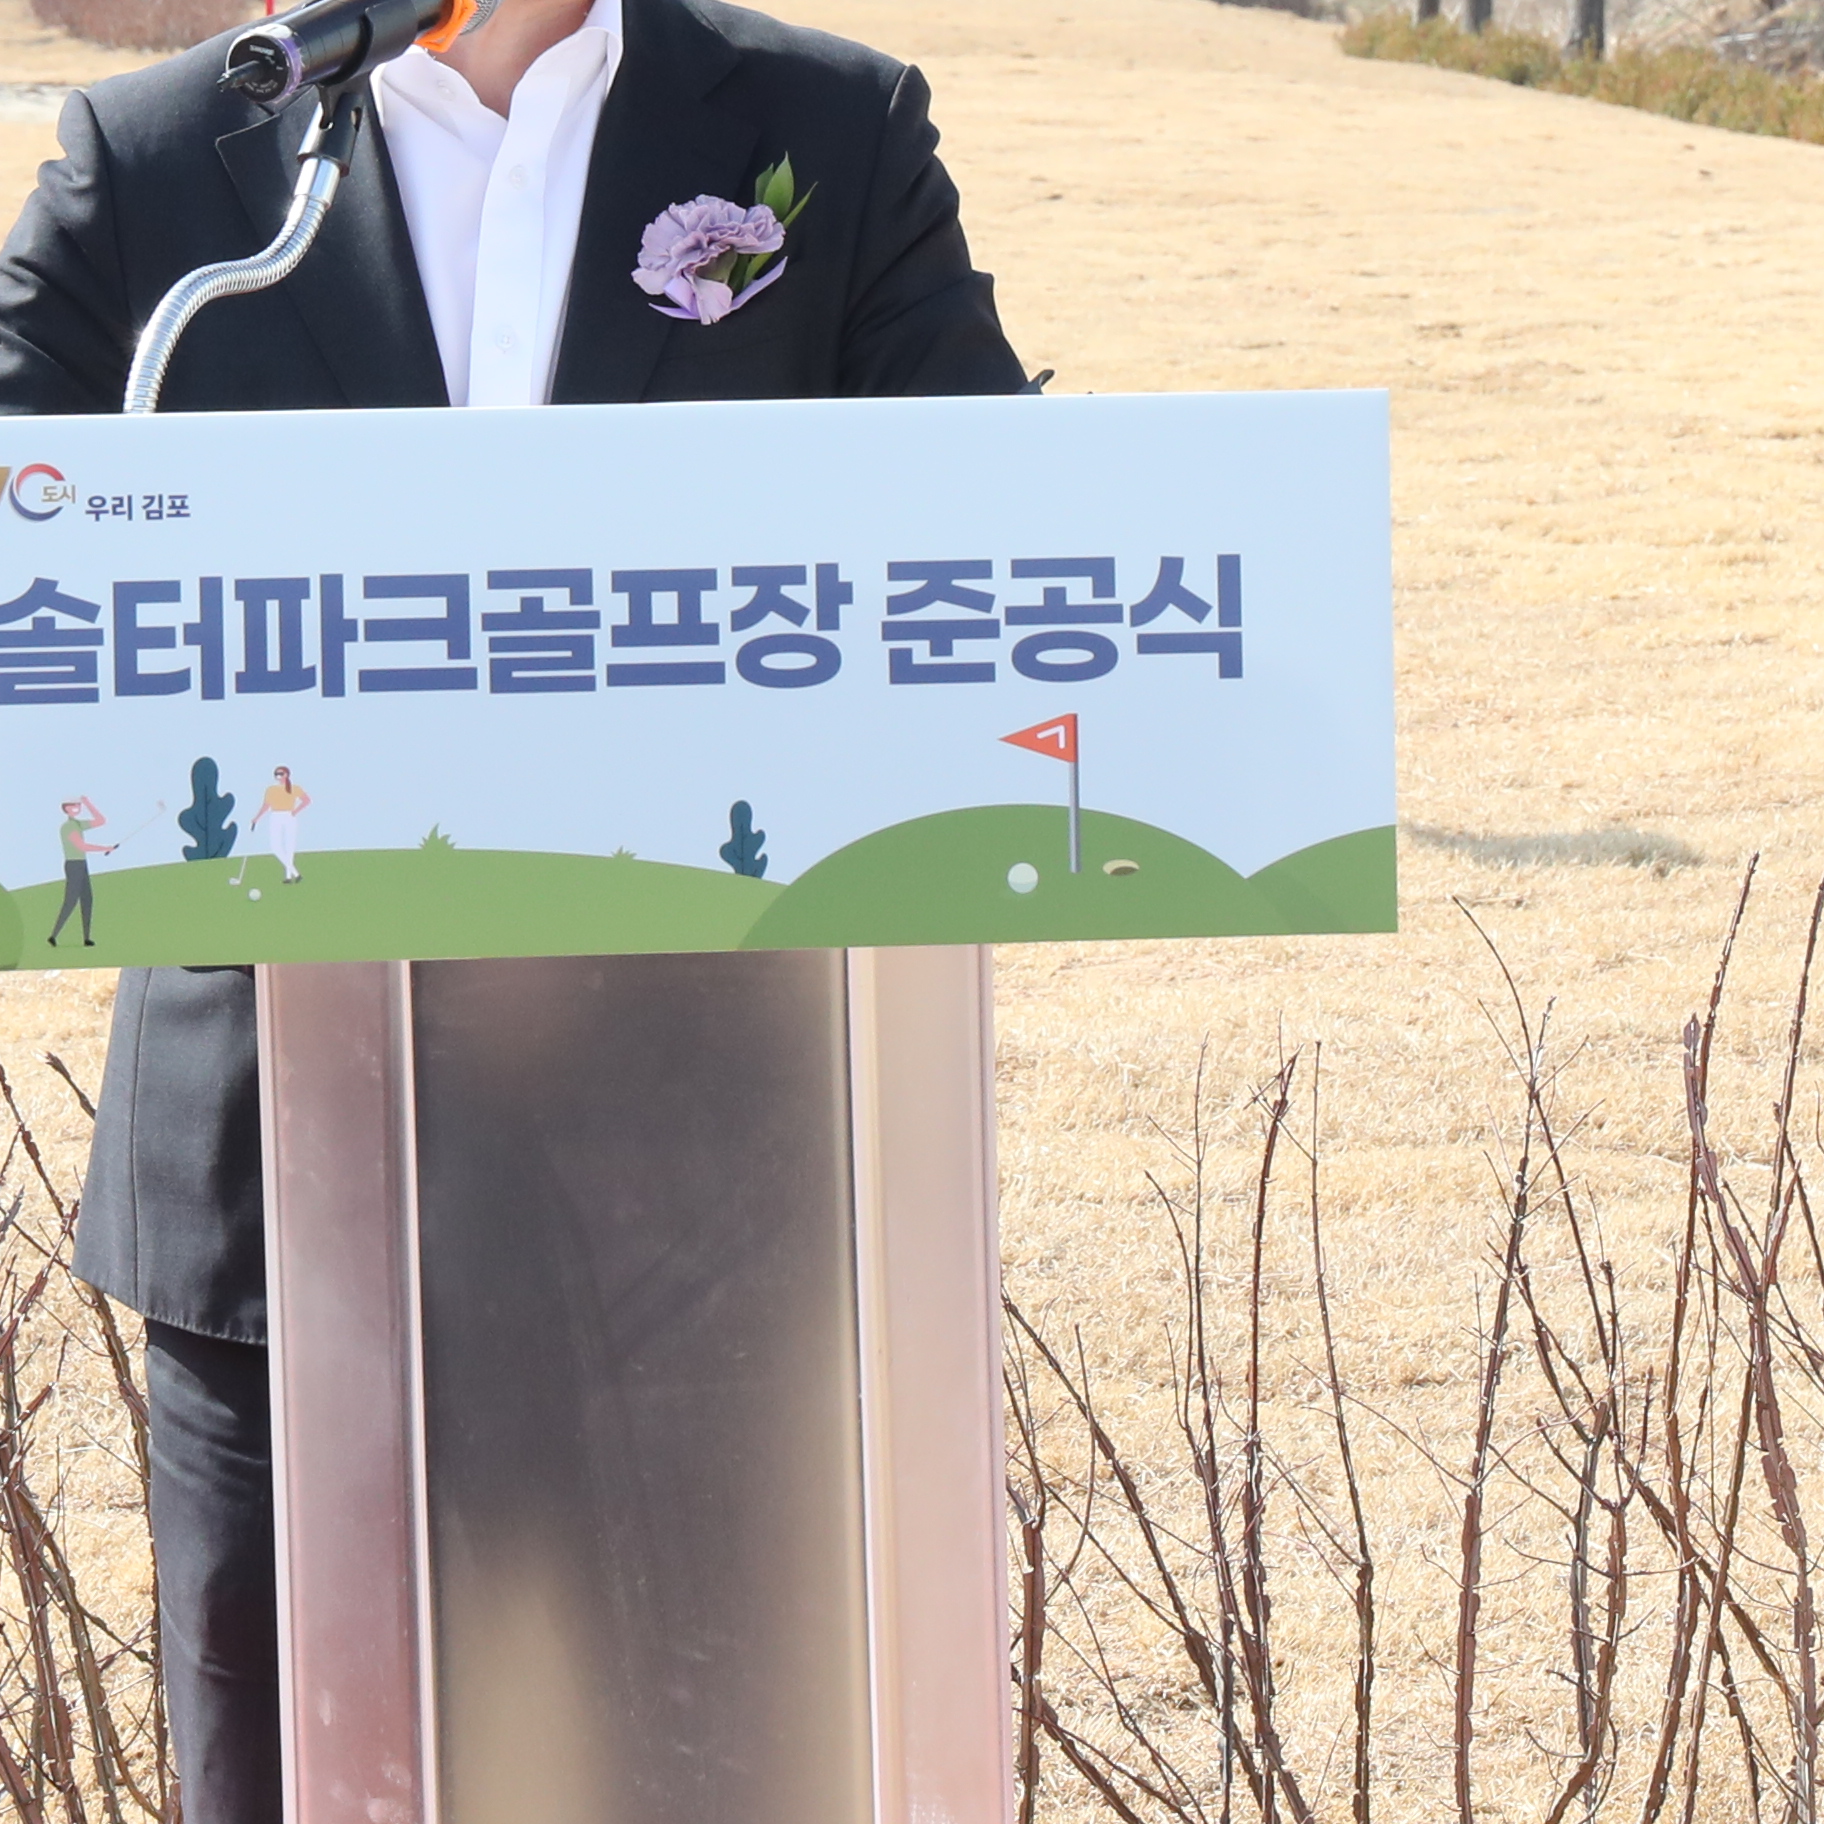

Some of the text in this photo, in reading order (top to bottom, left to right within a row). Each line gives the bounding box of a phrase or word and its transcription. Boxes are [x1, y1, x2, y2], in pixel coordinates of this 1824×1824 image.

[41, 484, 76, 505] 도시
[85, 494, 133, 522] 우리
[141, 493, 191, 522] 김포
[880, 553, 1244, 685] 준공식
